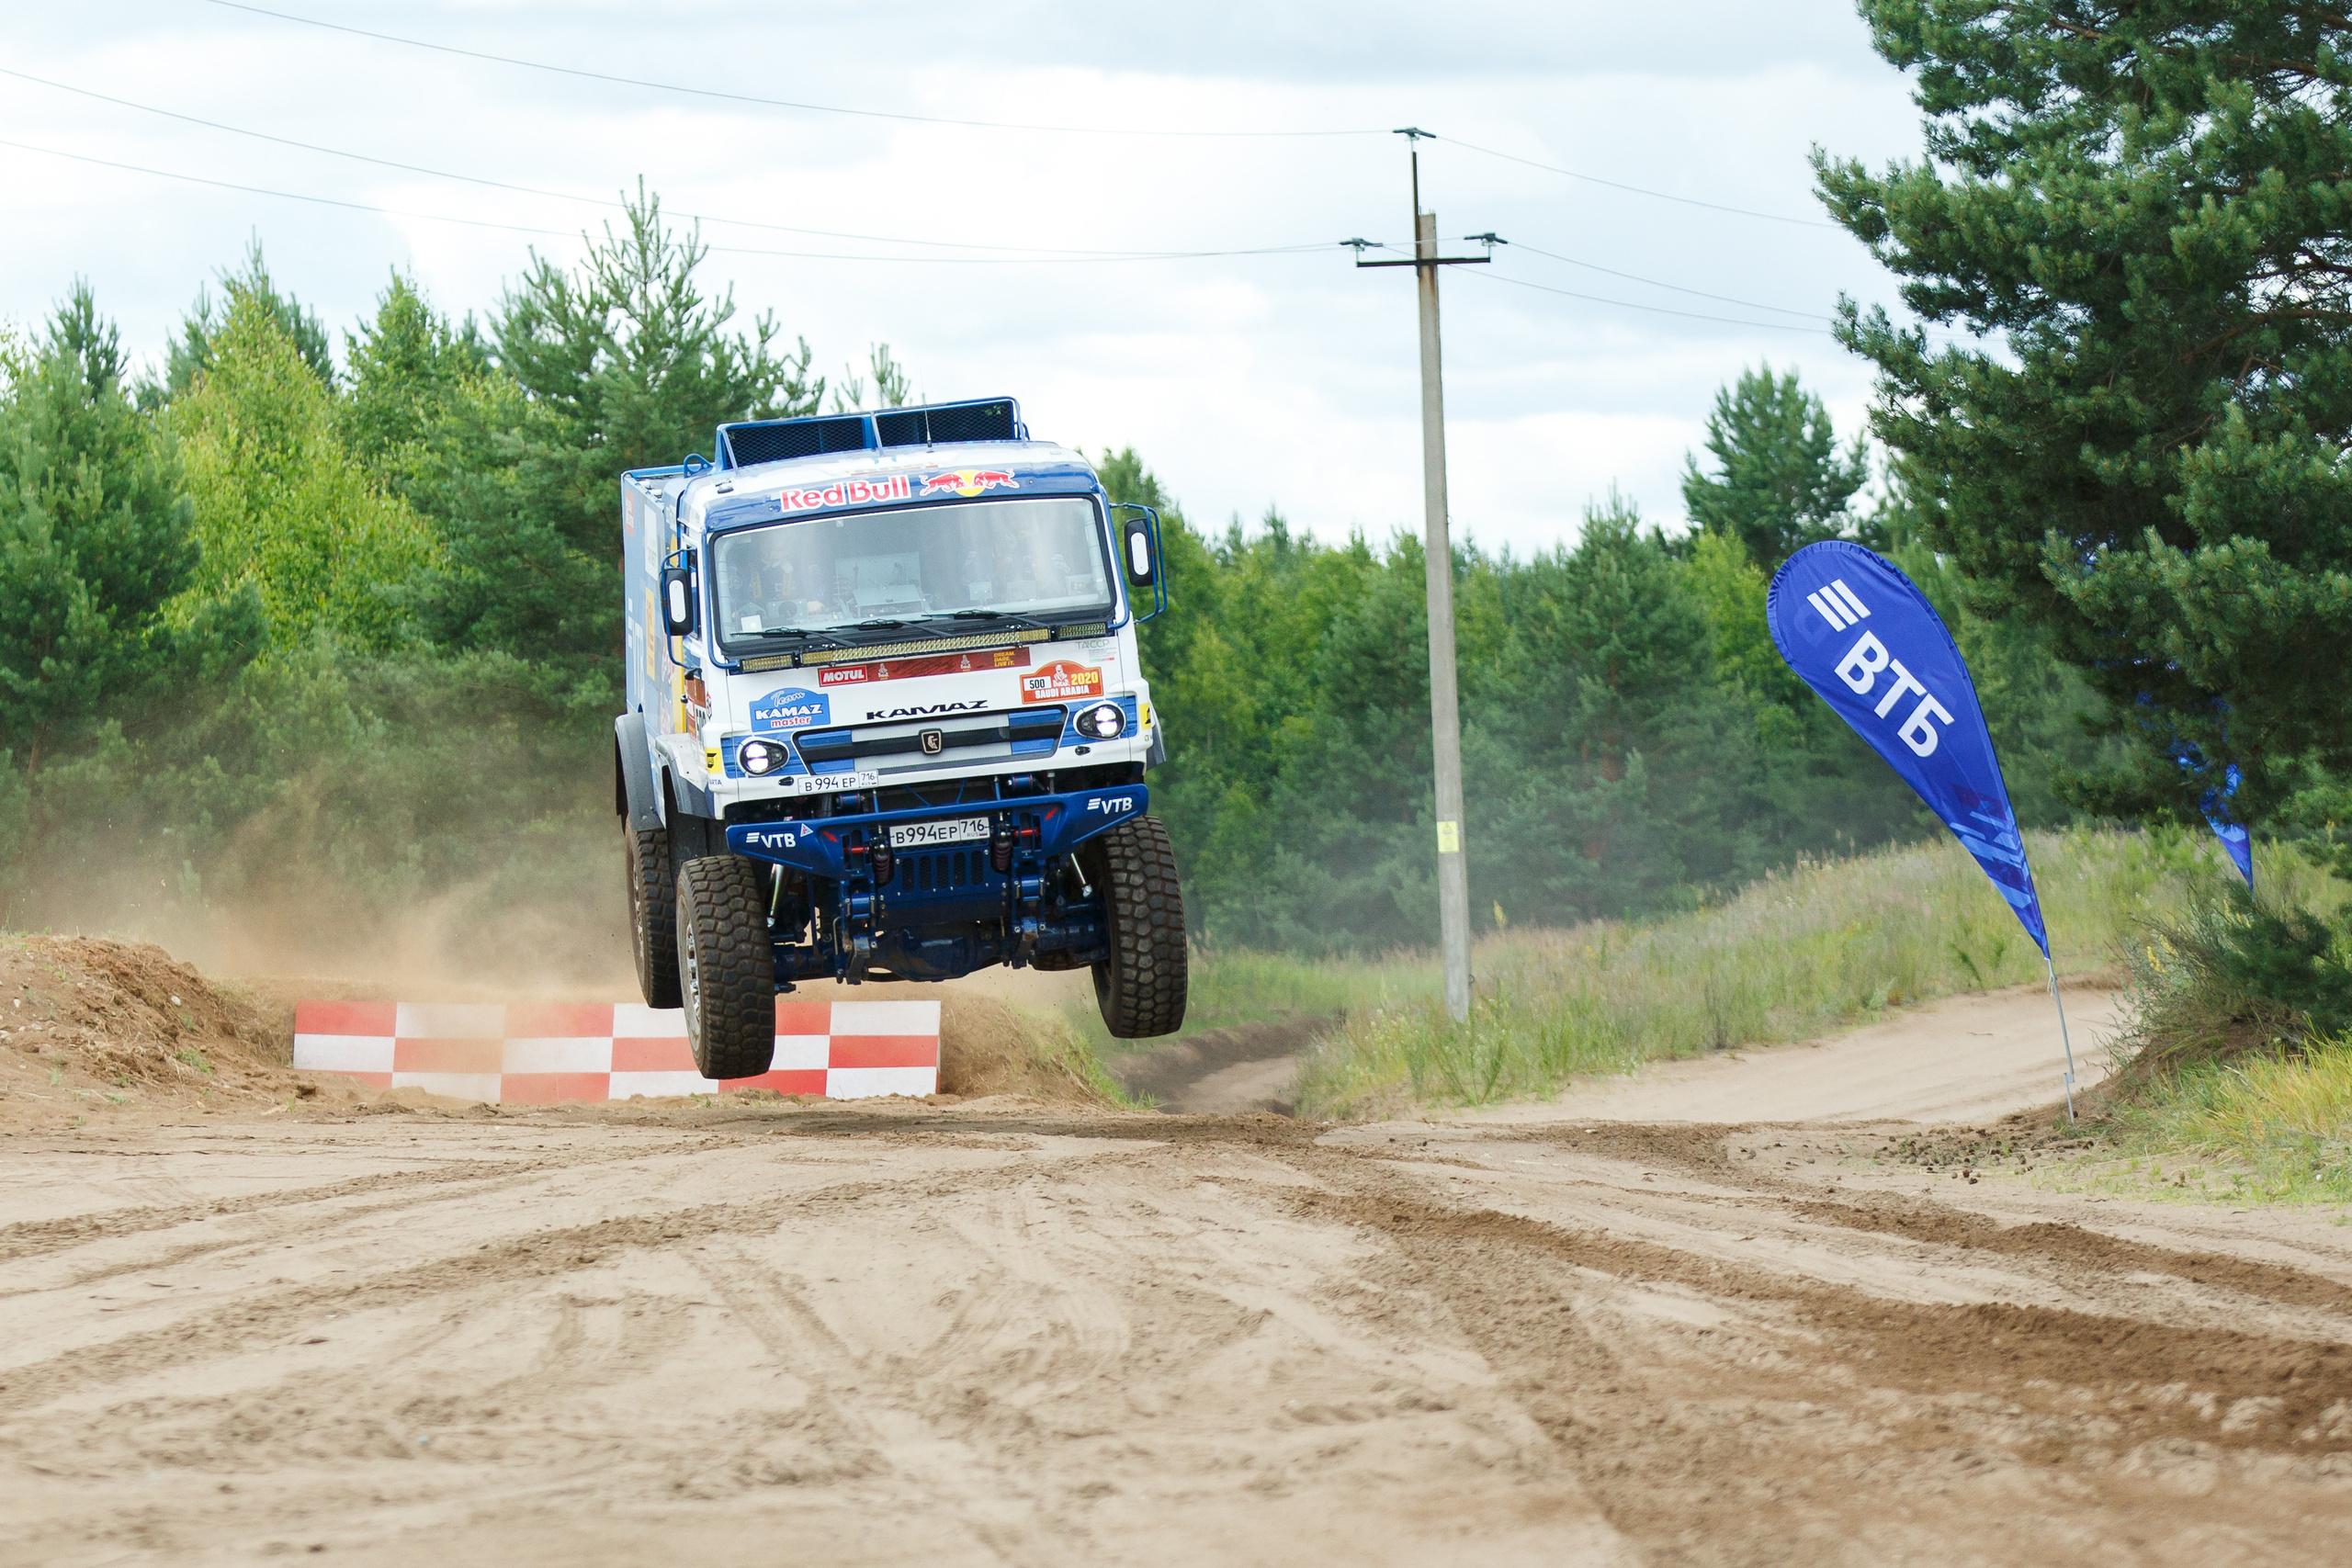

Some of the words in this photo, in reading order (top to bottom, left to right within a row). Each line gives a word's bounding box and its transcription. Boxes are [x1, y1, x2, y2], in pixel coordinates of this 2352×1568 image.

[782, 483, 843, 511] Red
[849, 476, 910, 502] Bull
[823, 669, 865, 684] MOTUL
[1030, 679, 1046, 689] 500
[1070, 671, 1099, 685] 2020
[771, 690, 806, 707] Team
[1035, 688, 1058, 699] SAUDI
[1060, 684, 1090, 697] ARABIA
[1833, 628, 1955, 759] ВТБ
[754, 703, 823, 720] KAMAZ
[865, 700, 989, 720] KAMAZ
[770, 715, 811, 728] master
[861, 773, 875, 782] 716
[1102, 797, 1132, 814] VTB
[960, 818, 985, 833] 716
[761, 833, 797, 849] VTB
